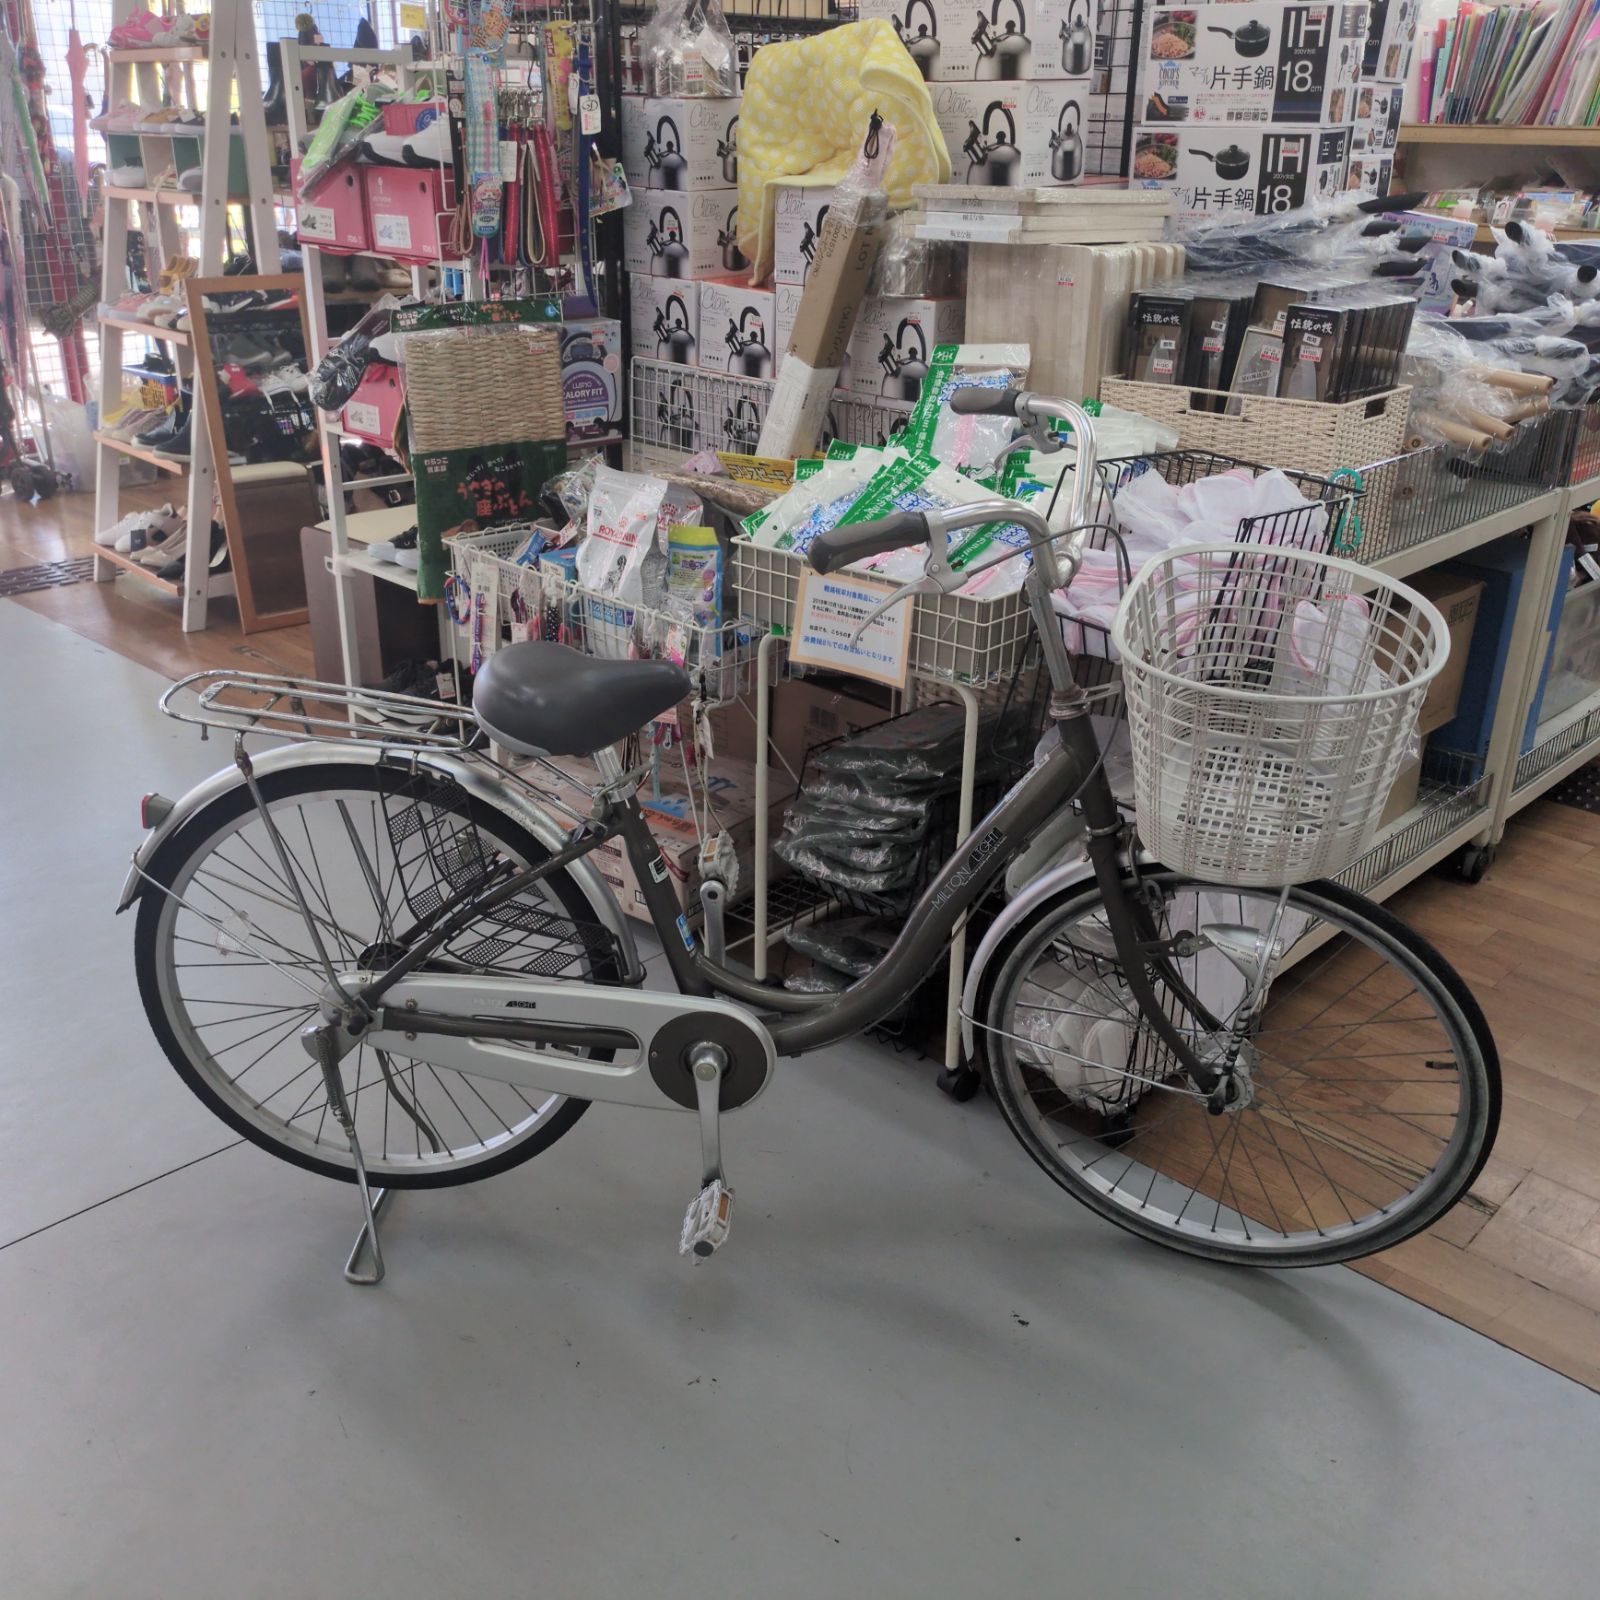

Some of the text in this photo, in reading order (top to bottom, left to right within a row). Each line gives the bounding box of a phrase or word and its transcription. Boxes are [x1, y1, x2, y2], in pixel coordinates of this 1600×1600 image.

[1288, 10, 1327, 47] IH
[1210, 65, 1275, 91] 片手鍋
[1281, 60, 1313, 92] 18
[1267, 137, 1305, 173] IH
[1192, 186, 1254, 212] 片手鍋
[1261, 184, 1293, 214] 18
[856, 243, 871, 271] LOT
[563, 387, 604, 400] ALORY FIT
[931, 866, 971, 911] MILTON
[970, 828, 1001, 862] LIGHT
